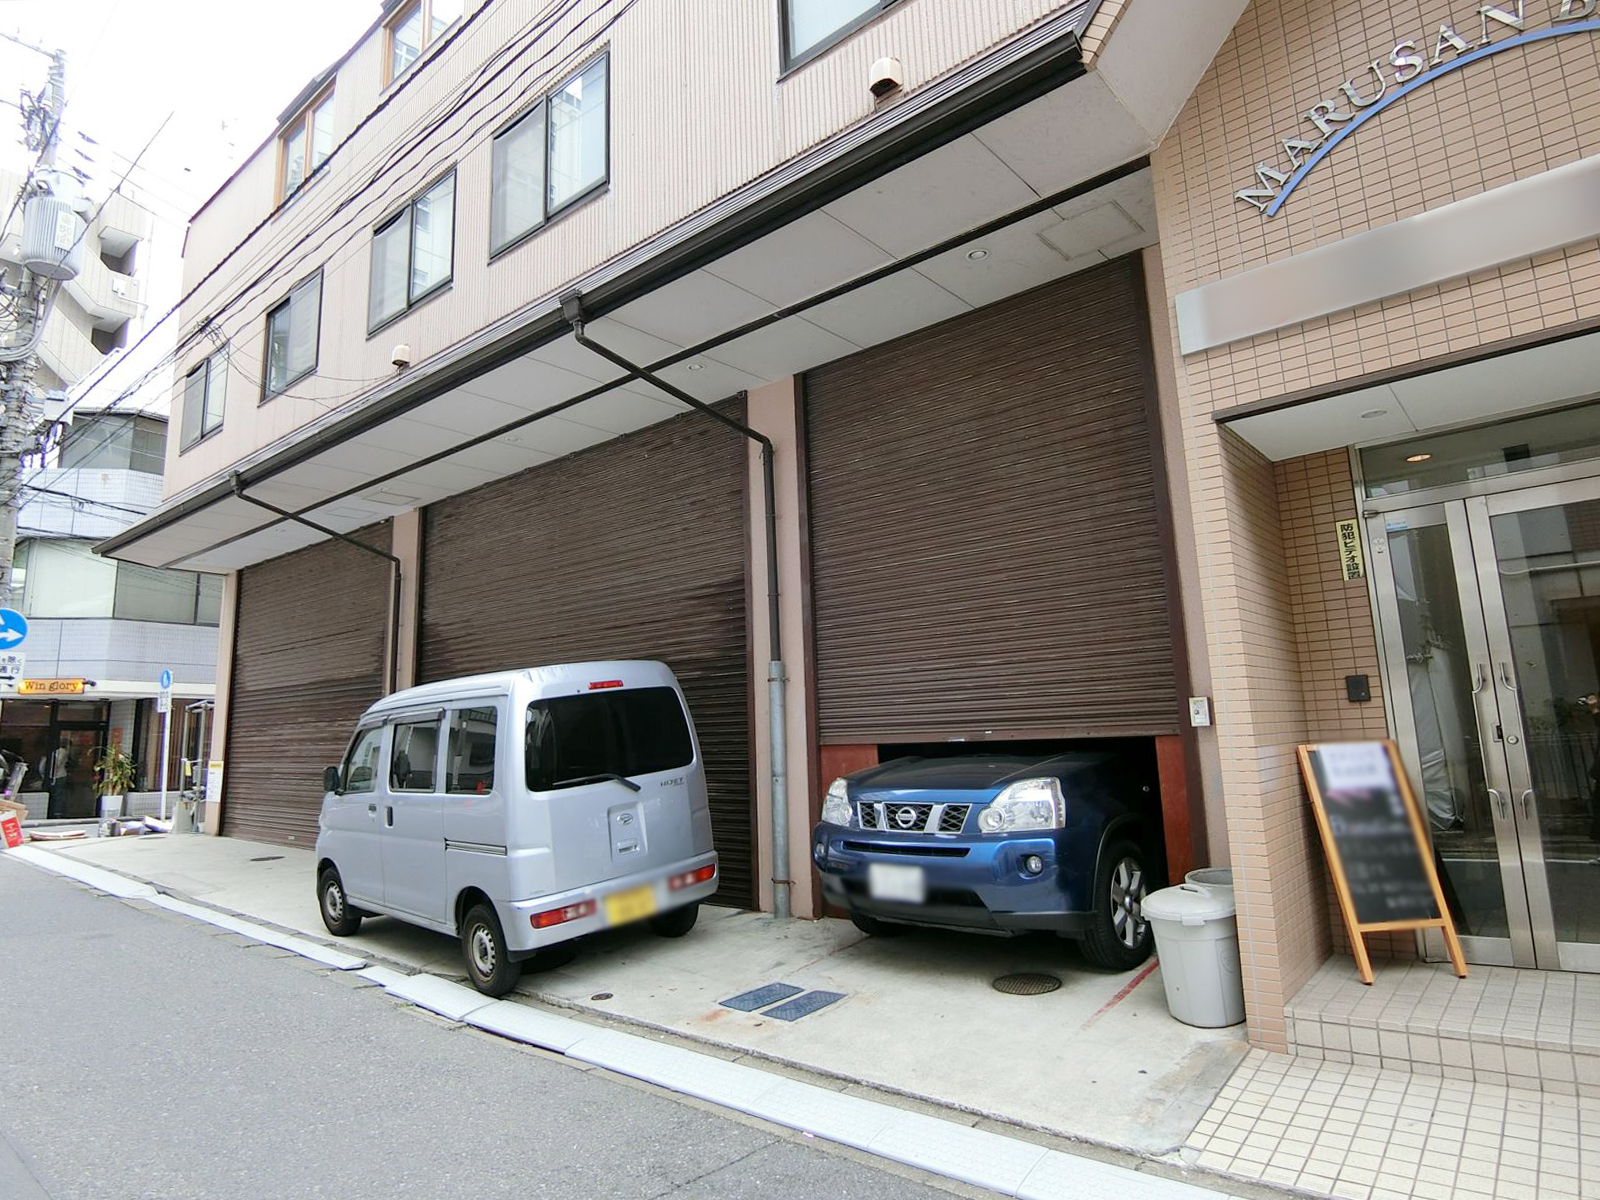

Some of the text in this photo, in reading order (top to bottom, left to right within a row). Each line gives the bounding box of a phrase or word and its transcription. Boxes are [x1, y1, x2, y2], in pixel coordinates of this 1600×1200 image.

[1235, 0, 1527, 212] MARUSAN
[25, 681, 78, 692] Win glory
